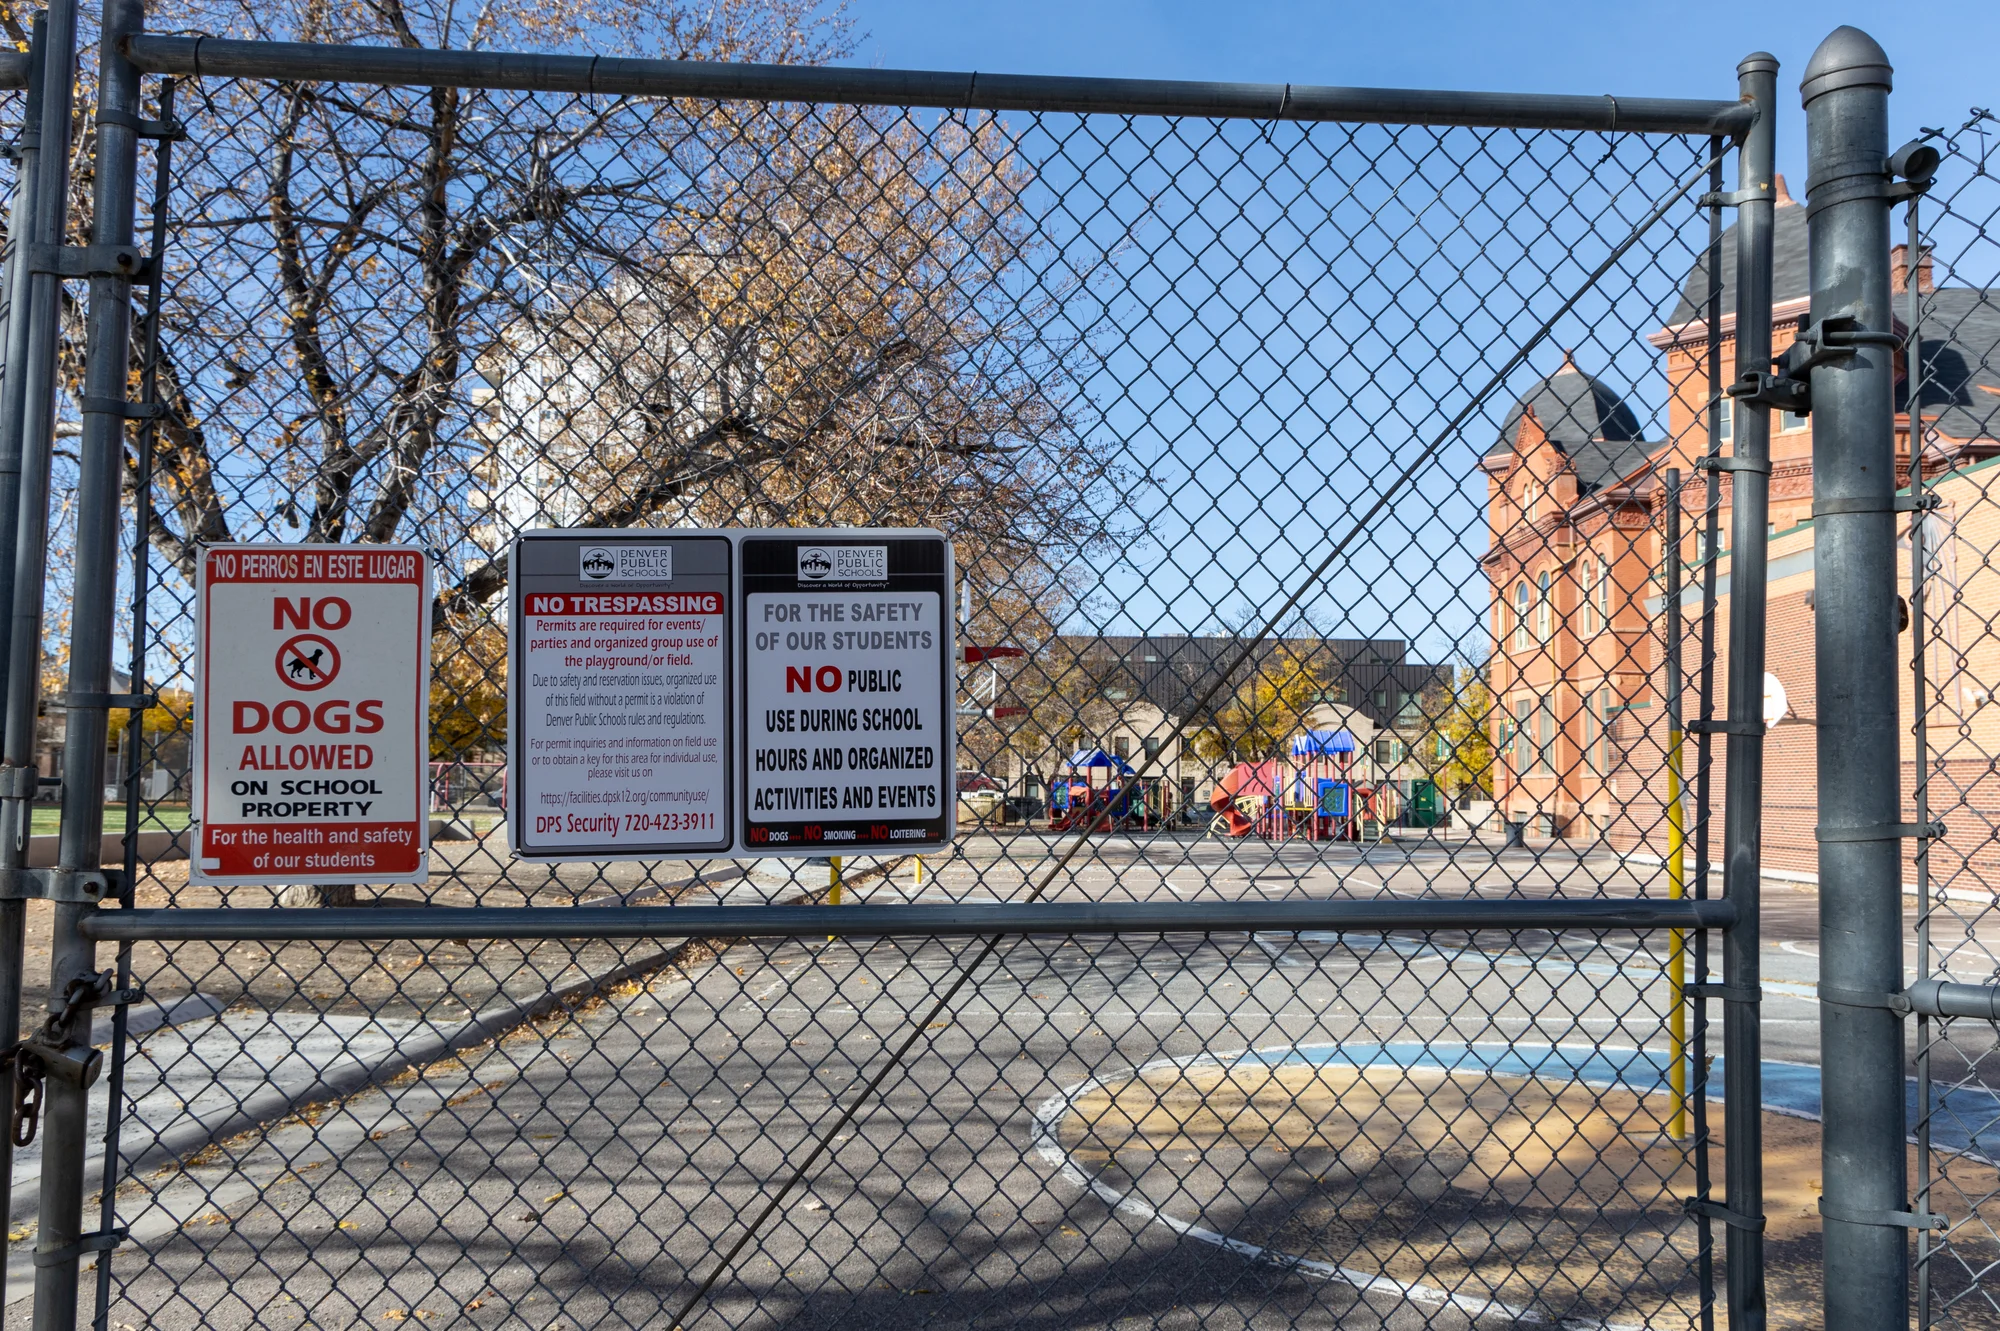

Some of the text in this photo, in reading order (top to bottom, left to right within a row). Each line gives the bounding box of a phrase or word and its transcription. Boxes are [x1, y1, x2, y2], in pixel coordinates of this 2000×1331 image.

[621, 550, 667, 558] DENVER
[838, 550, 883, 558] DENVER
[215, 554, 415, 579] NO PERROS EN ESTE LUGAR
[621, 559, 667, 568] PUBLIC
[838, 559, 883, 567] PUBLIC
[534, 596, 716, 613] NO TRESPASSING
[764, 603, 923, 622] FOR THE SAFETY
[273, 596, 352, 631] NO
[536, 618, 706, 634] Permits are required for events/
[530, 636, 719, 652] parties and organized group use of
[755, 631, 932, 651] OF OUR STUDENTS
[565, 654, 693, 670] the playground/or field.
[533, 672, 717, 690] Due to safety and reservation issues, organized use
[786, 665, 902, 693] NO PUBLIC
[546, 691, 705, 709] of this field without a permit is a violation of
[233, 700, 384, 734] DOGS
[546, 712, 706, 728] Denver Public Schools rules and regulations.
[766, 708, 922, 732] USE DURING SCHOOL
[530, 736, 717, 751] For permit inquiries and information on field use
[239, 745, 374, 770] ALLOWED
[532, 752, 718, 767] or to obtain a key for this area for individual use,
[756, 747, 934, 771] HOURS AND ORGANIZED
[588, 768, 653, 781] please visit us on
[231, 779, 383, 795] ON SCHOOL
[540, 788, 710, 807] https://facilities.dpsk12.org/communityuse/
[754, 785, 936, 810] ACTIVITIES AND EVENTS
[242, 801, 373, 817] PROPERTY
[536, 813, 714, 838] DPS Security 720-423-3911
[750, 828, 768, 842] NO
[804, 825, 821, 840] NO
[871, 825, 888, 839] NO
[212, 827, 412, 846] For the health and safety
[253, 852, 375, 868] of our students
